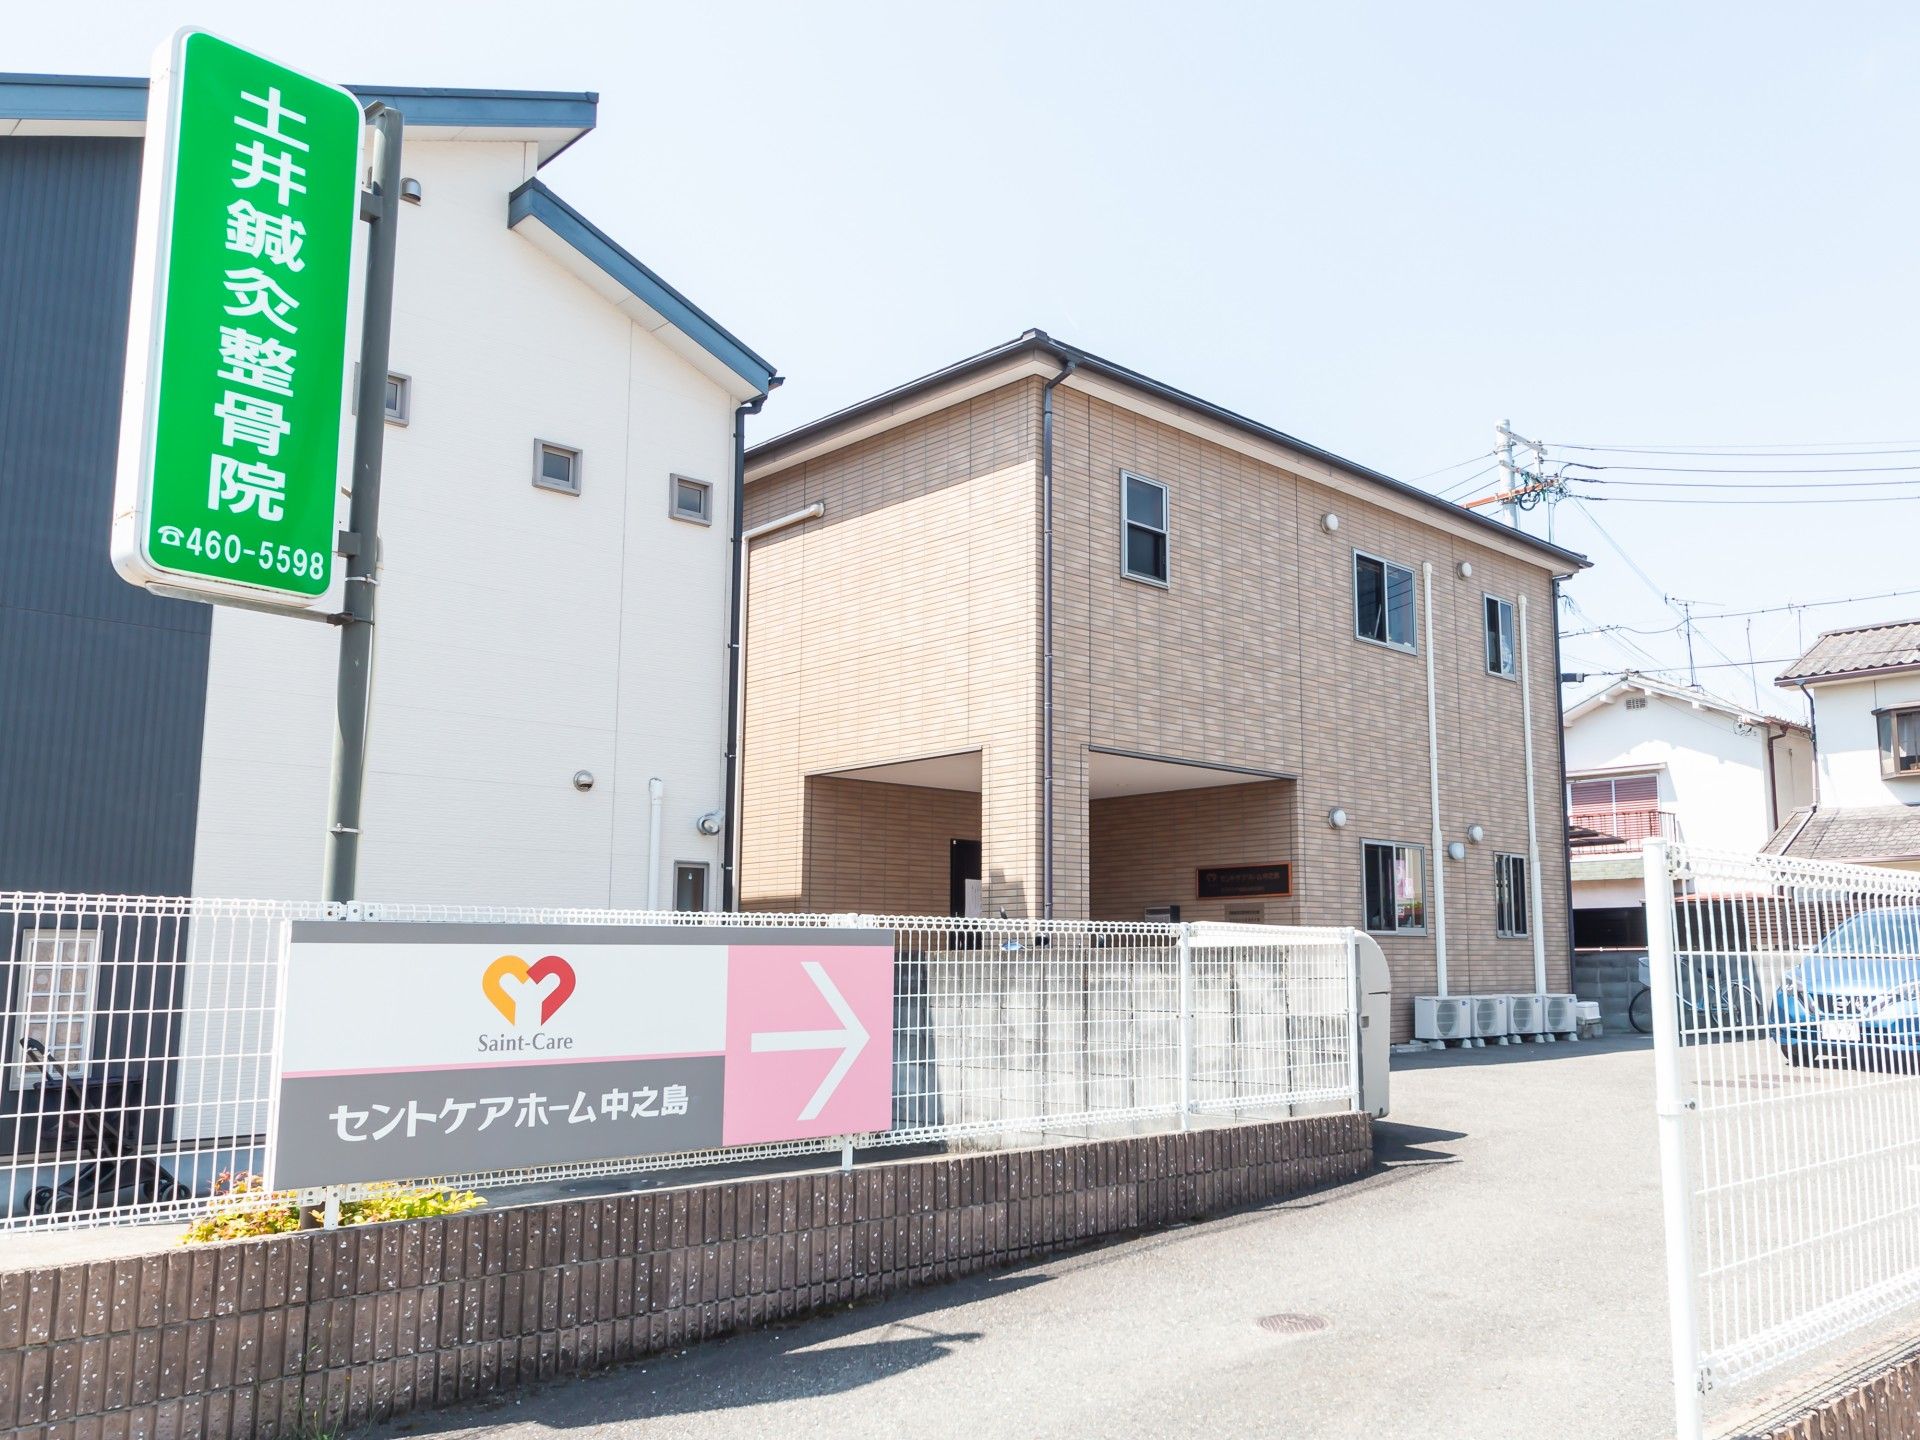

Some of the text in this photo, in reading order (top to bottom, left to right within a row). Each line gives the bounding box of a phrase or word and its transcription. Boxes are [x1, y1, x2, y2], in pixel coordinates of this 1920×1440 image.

[208, 87, 310, 522] 土井鍼灸整骨院
[186, 527, 324, 580] 460-5598
[478, 1033, 573, 1052] Saint-Care
[329, 1084, 689, 1142] セントケアホーム中之島
